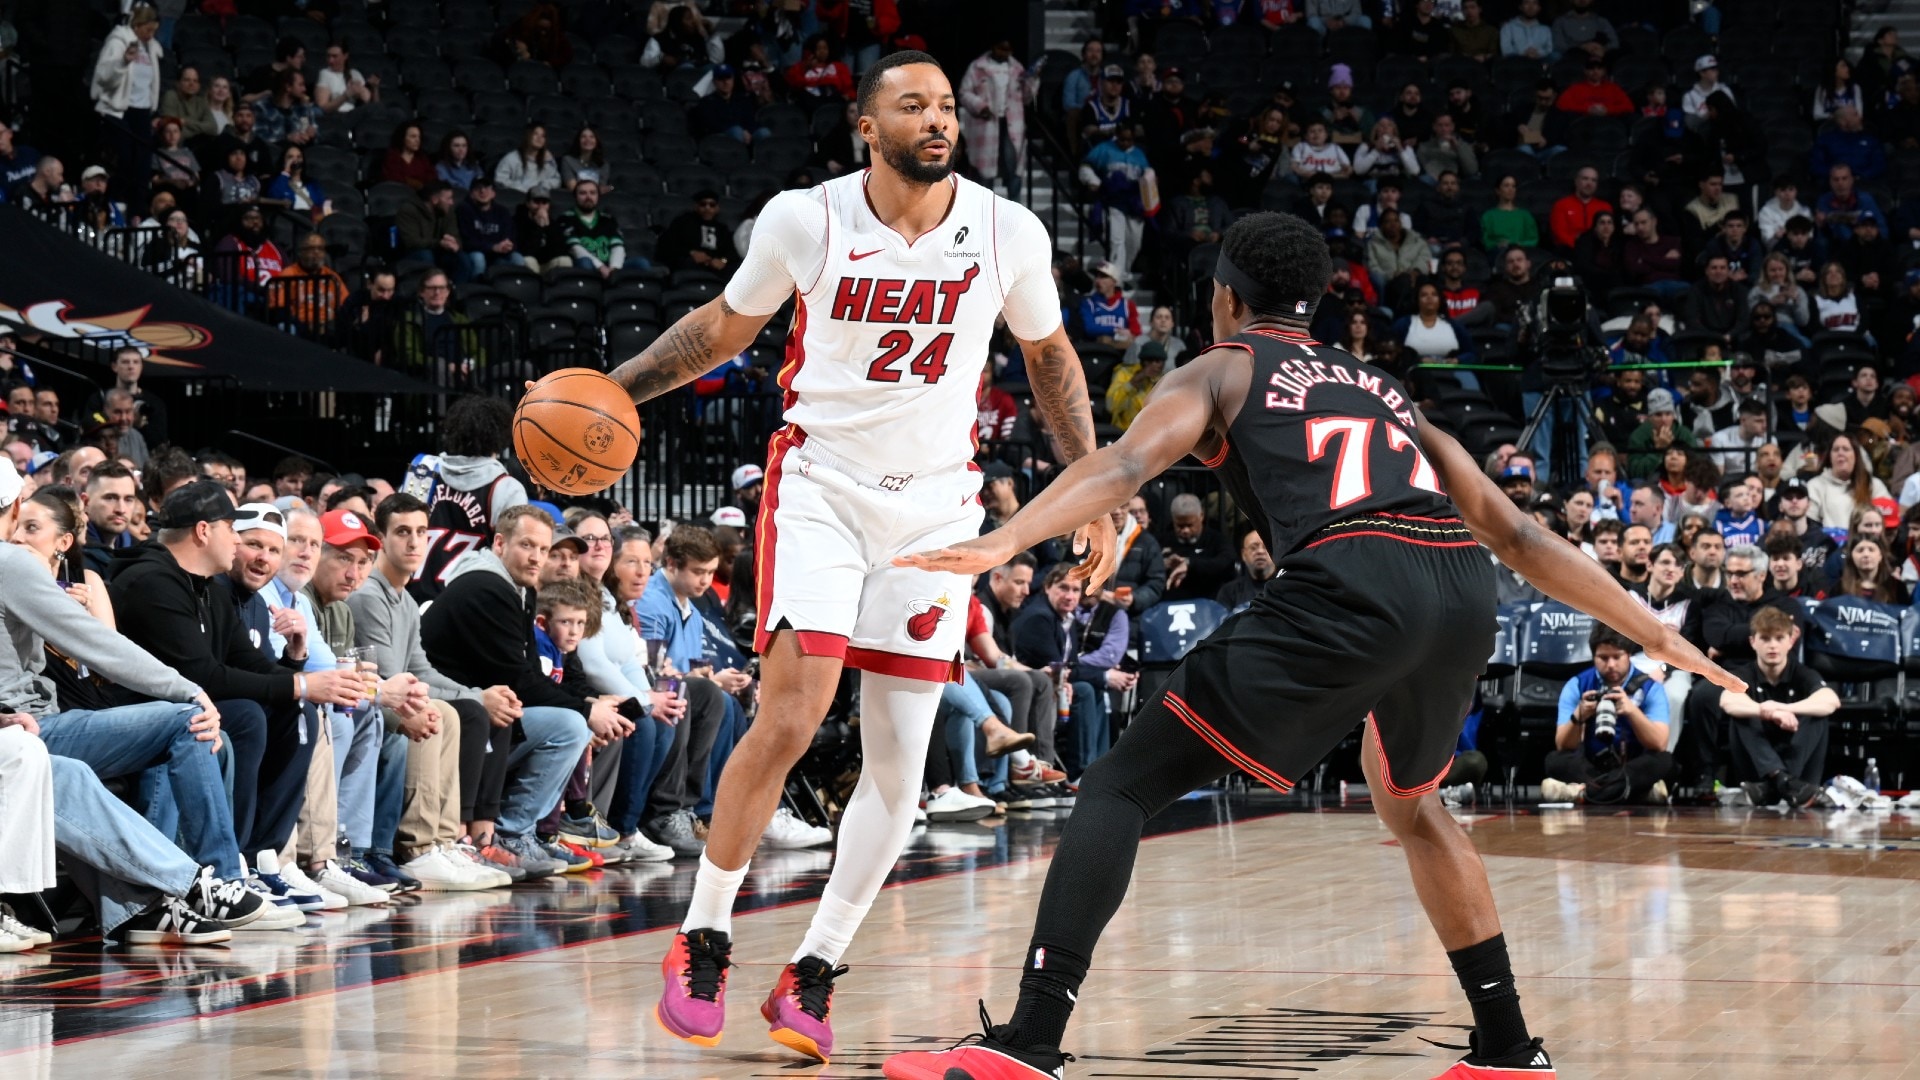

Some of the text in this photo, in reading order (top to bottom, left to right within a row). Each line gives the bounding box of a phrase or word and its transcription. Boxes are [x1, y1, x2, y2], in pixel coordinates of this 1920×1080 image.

[944, 250, 981, 258] Robinhood
[830, 261, 981, 325] HEAT
[866, 329, 955, 385] 24
[1265, 359, 1416, 428] EDGECOMBE
[1540, 612, 1575, 630] NJM
[1838, 605, 1872, 625] NJM
